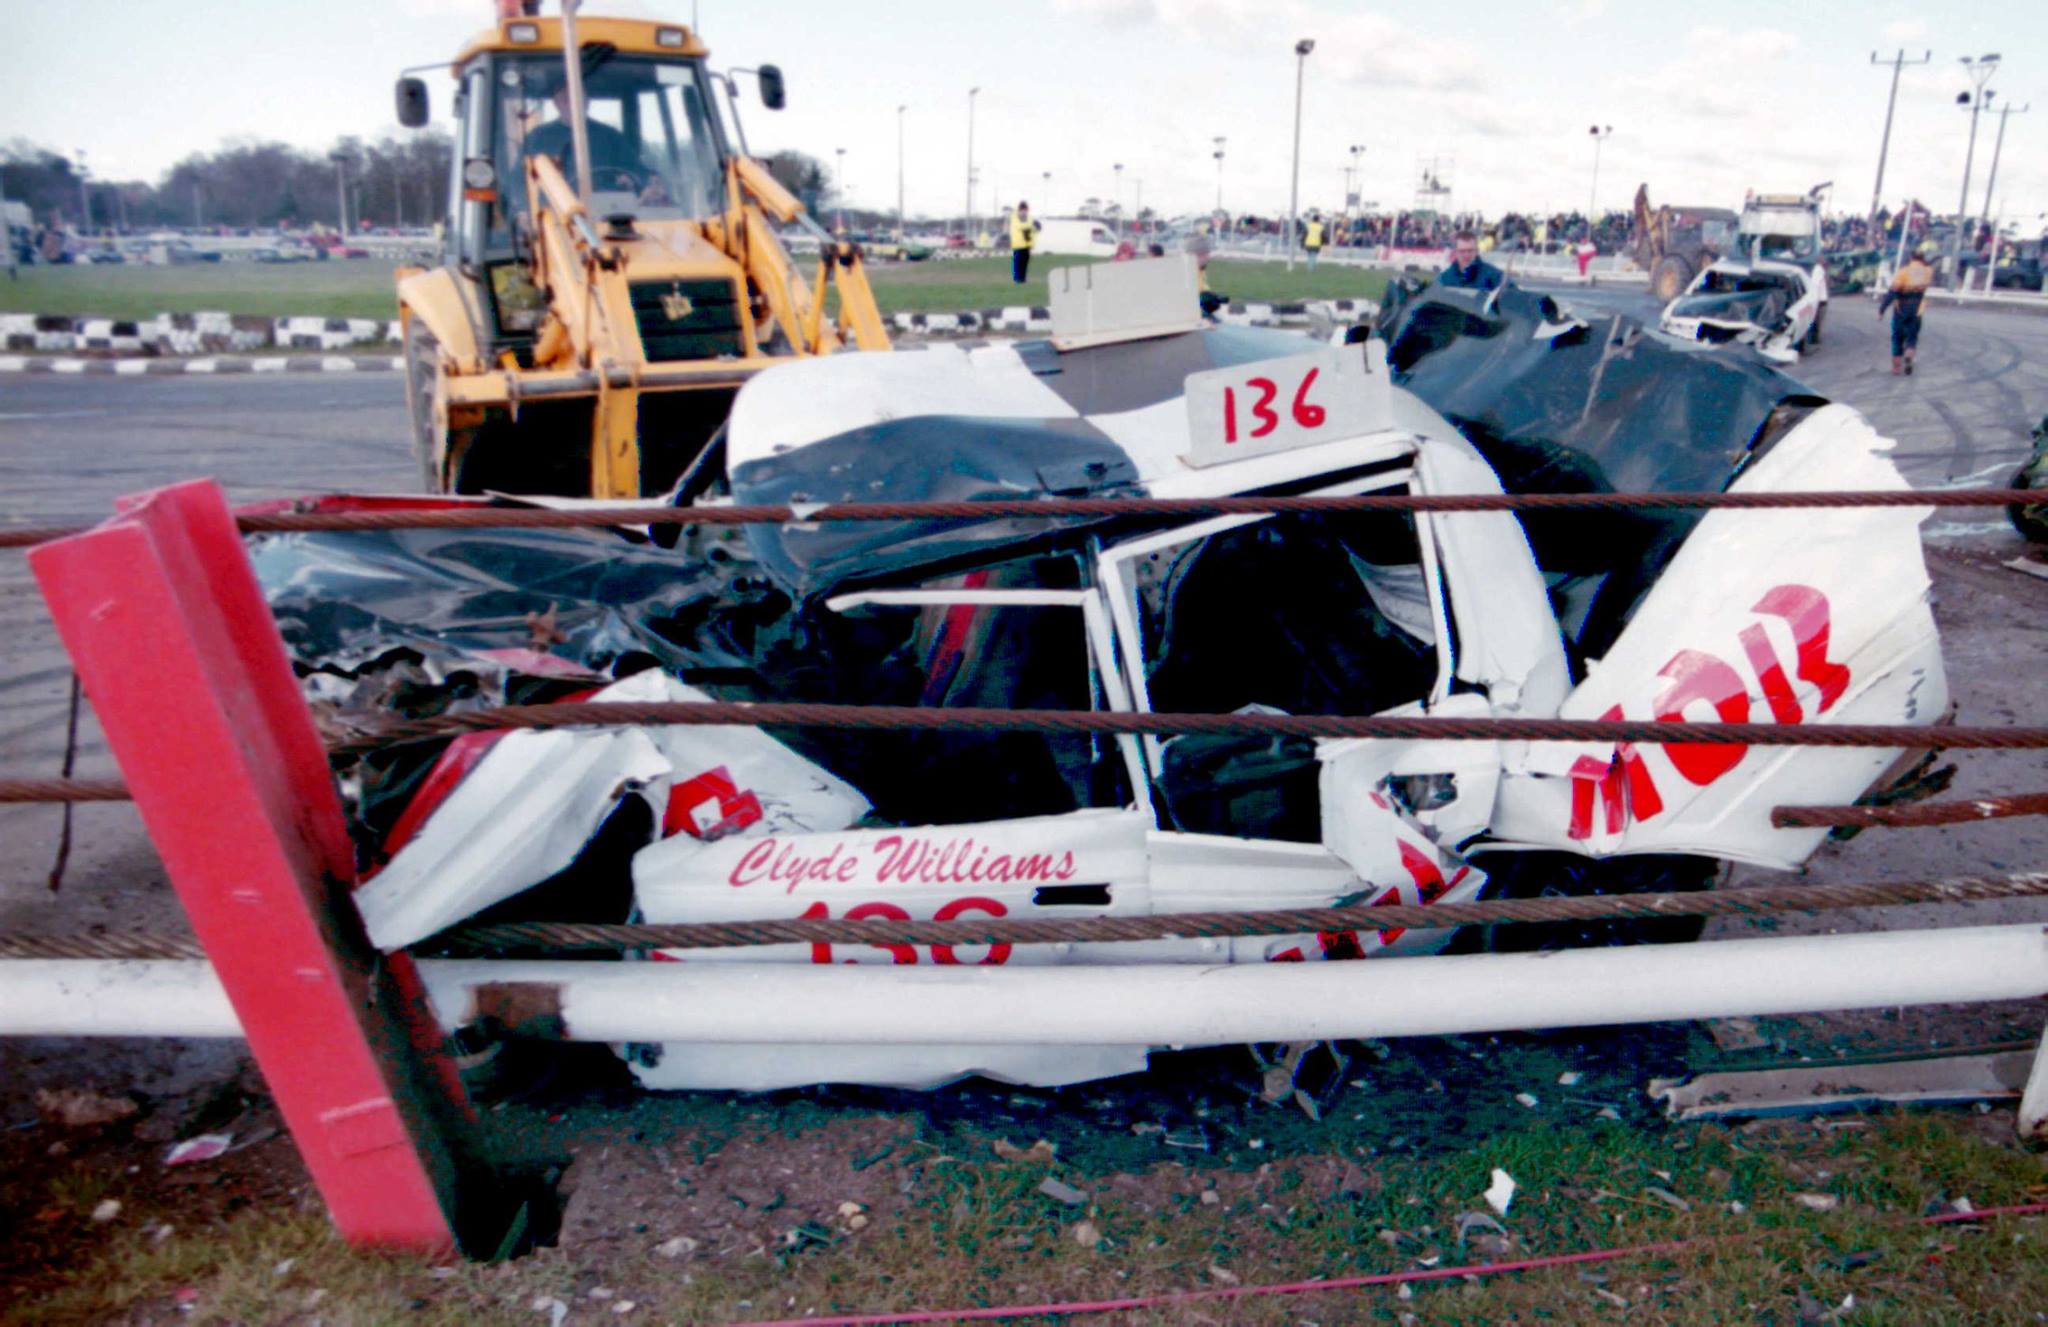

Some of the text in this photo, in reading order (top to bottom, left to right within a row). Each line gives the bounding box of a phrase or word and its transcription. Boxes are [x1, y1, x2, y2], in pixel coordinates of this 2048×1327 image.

[1224, 366, 1325, 443] 136
[729, 835, 1078, 894] Clyde Williams
